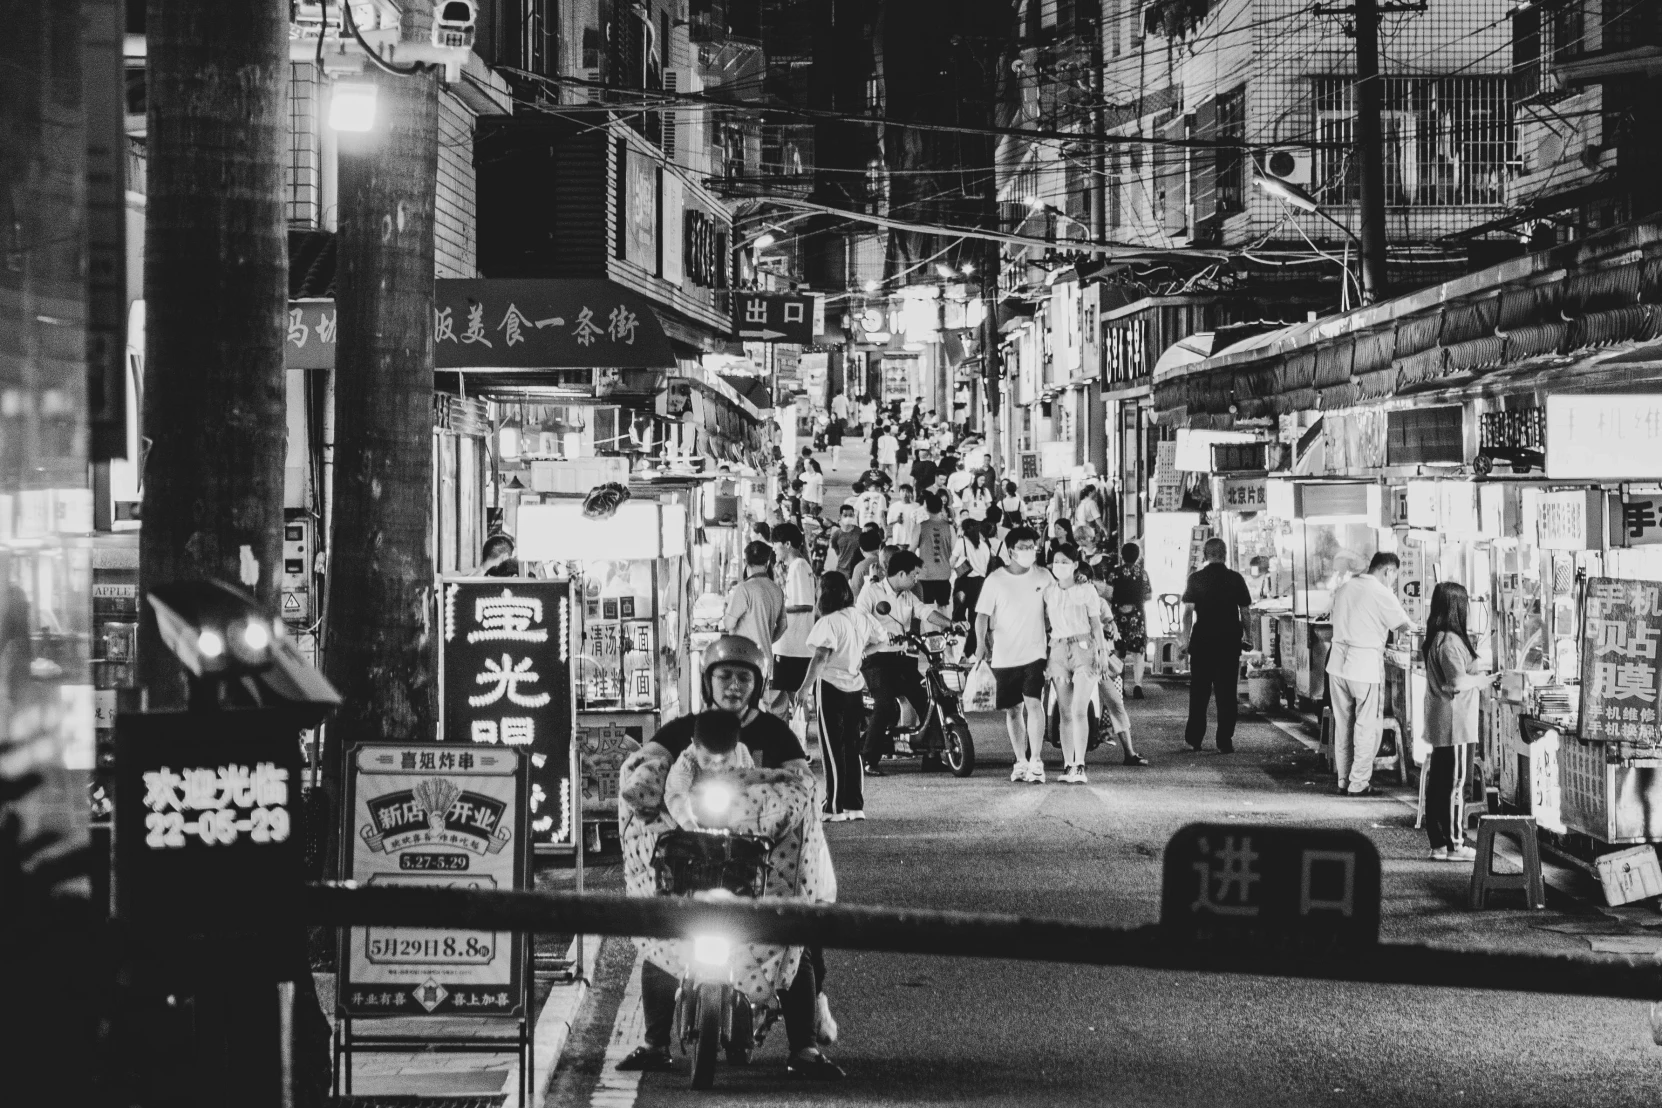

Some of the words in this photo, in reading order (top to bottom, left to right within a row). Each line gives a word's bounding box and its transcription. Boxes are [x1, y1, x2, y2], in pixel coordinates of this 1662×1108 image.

[745, 299, 804, 323] 出口
[94, 586, 131, 596] APPLE
[1596, 583, 1662, 617] 手机
[1594, 620, 1660, 659] 贴
[1590, 662, 1657, 702] 膜
[1587, 705, 1656, 722] 手机维修
[401, 750, 475, 770] 喜姐炸串
[142, 761, 290, 813] 欢迎光临
[145, 806, 291, 849] 22-05-29
[378, 798, 425, 830] 新店
[450, 801, 496, 831] 开业
[402, 855, 467, 869] 5.27-5.29
[1190, 836, 1356, 917] 进口
